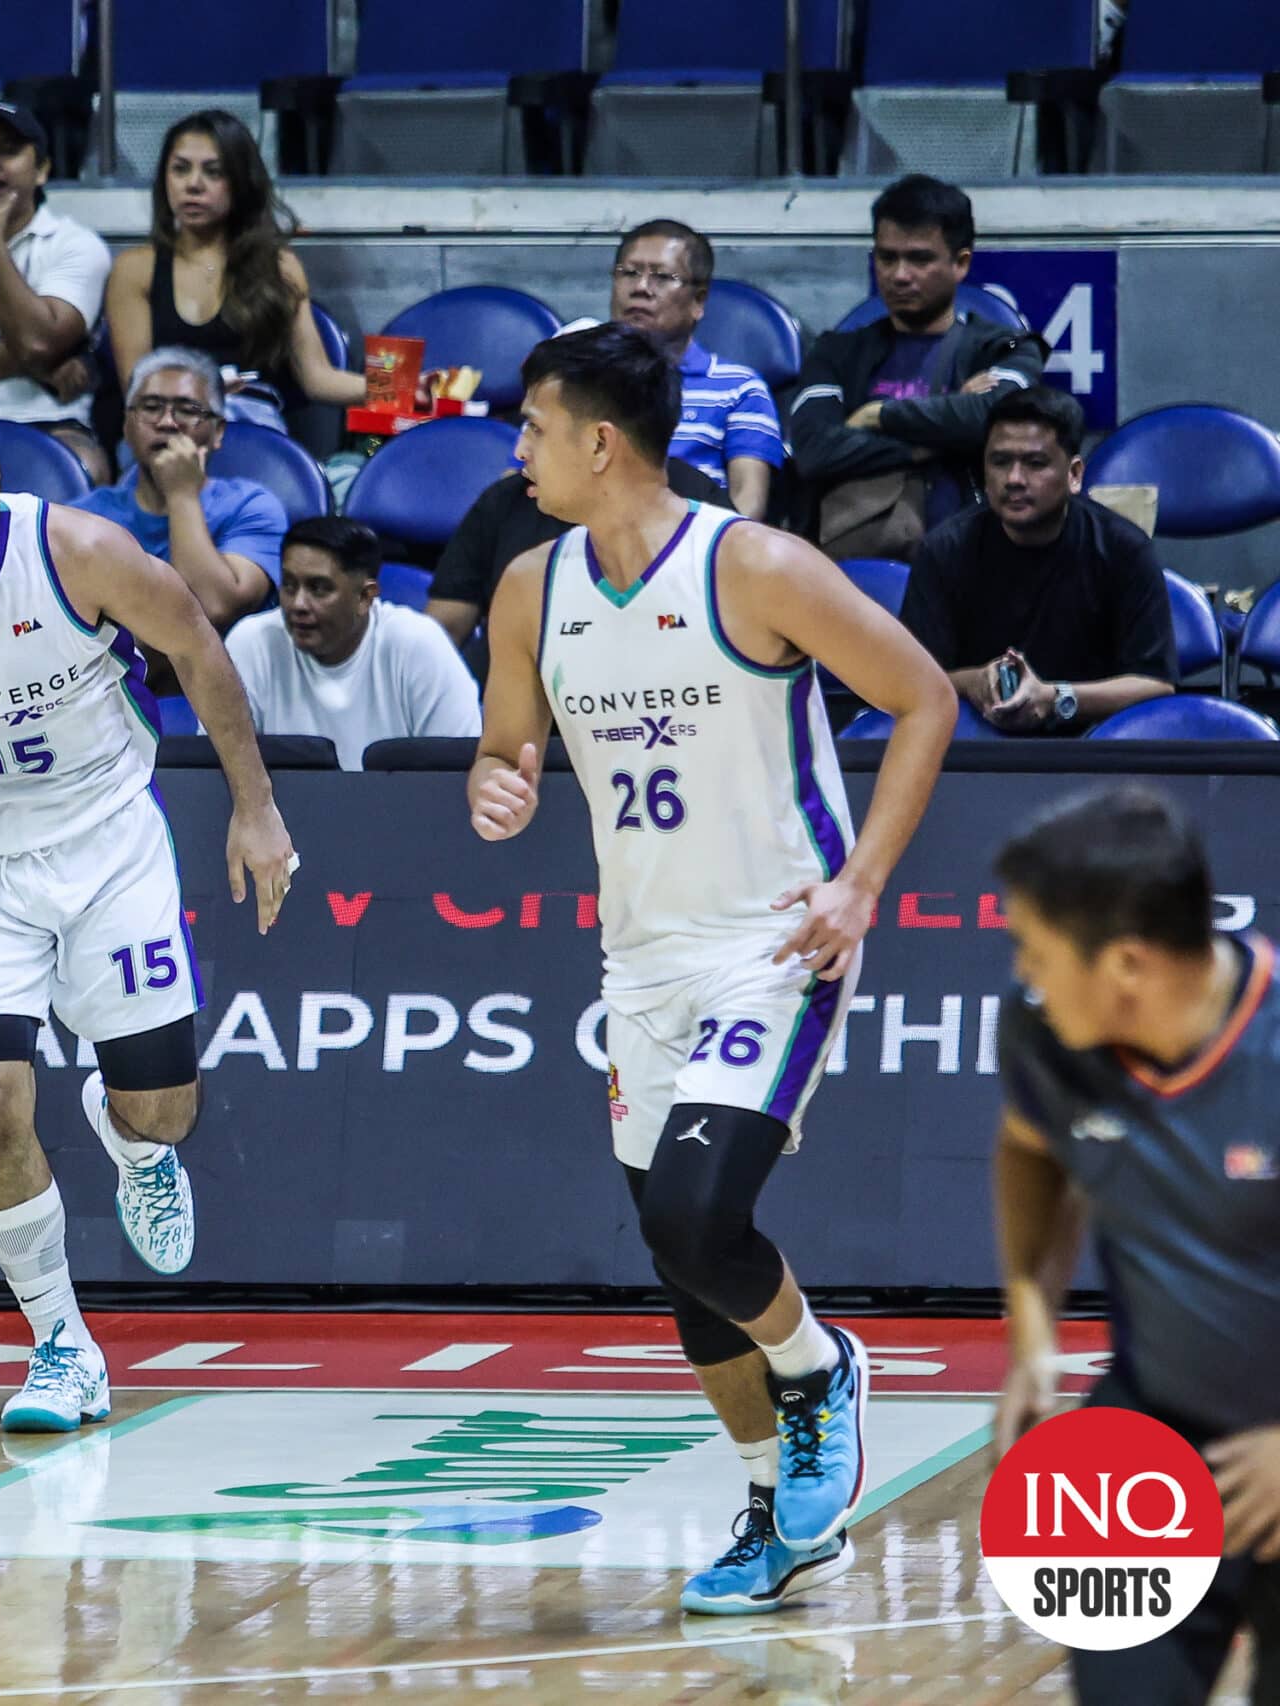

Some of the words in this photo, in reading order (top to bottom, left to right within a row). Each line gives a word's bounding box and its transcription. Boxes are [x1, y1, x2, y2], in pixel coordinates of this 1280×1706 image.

[12, 617, 43, 637] PBA
[657, 614, 688, 631] PBA
[564, 685, 722, 715] CONVERGE
[611, 765, 688, 834] 26
[109, 935, 179, 997] 15
[199, 991, 536, 1072] APPS
[688, 1018, 771, 1070] 26
